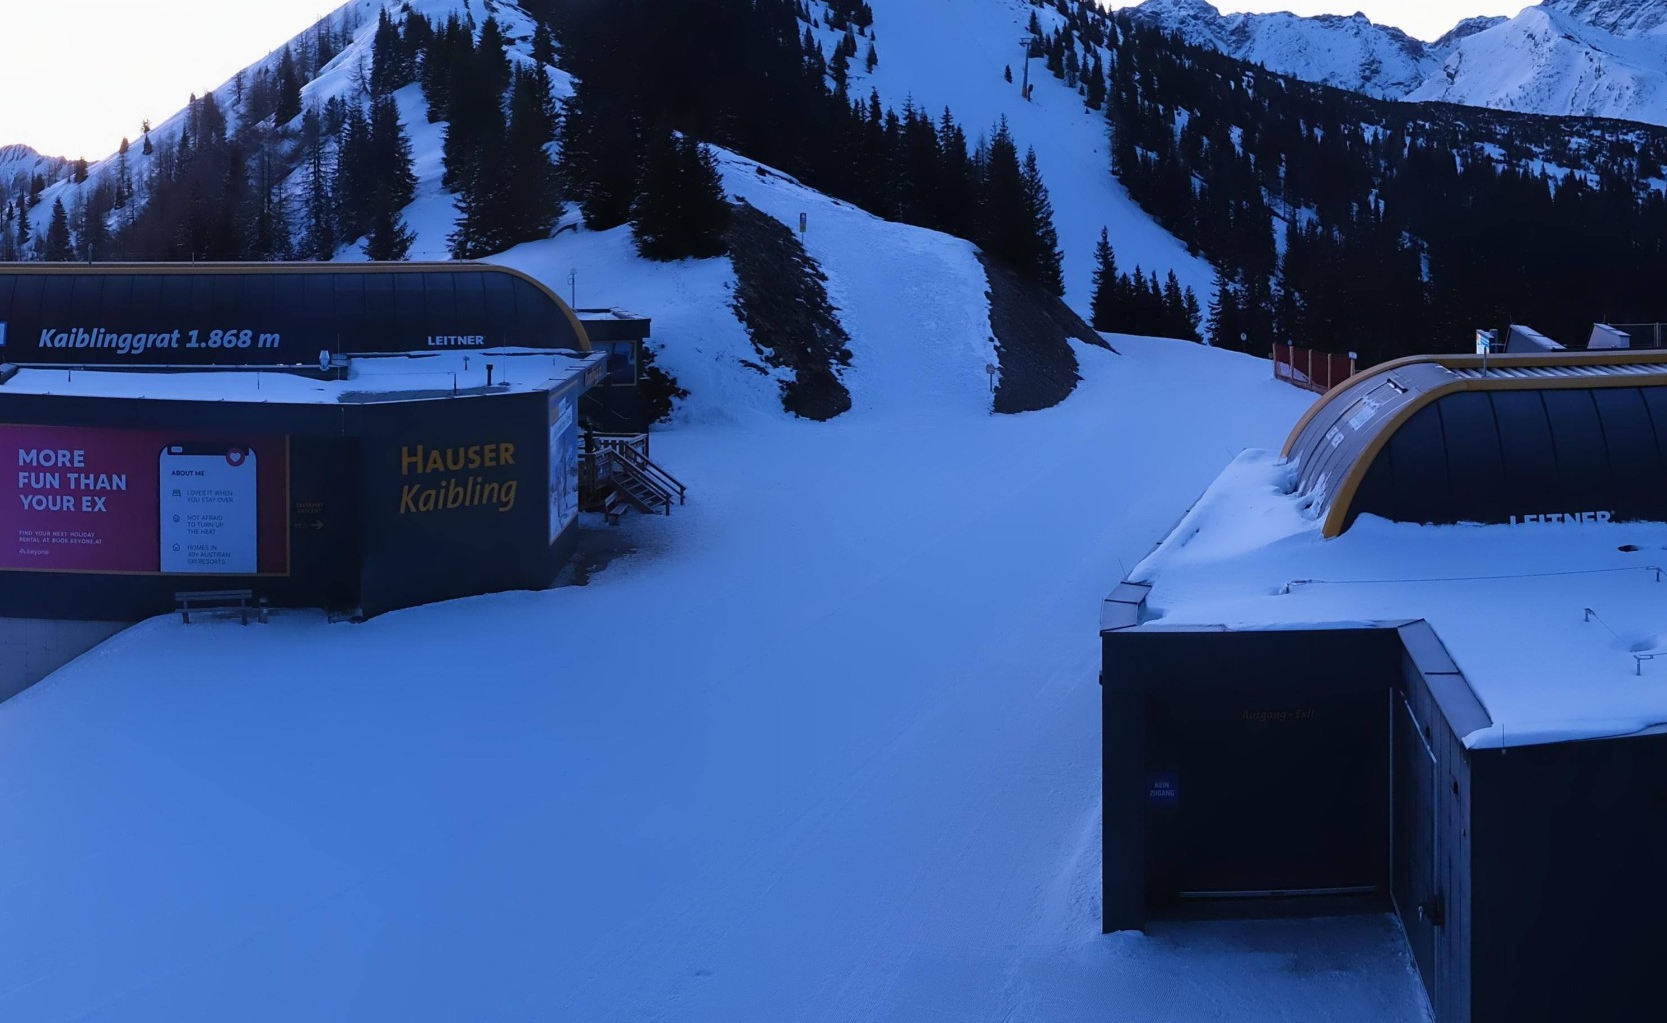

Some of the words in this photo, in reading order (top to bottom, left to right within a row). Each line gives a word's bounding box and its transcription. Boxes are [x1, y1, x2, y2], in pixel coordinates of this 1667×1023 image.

[38, 327, 181, 354] Kaiblinggrat
[185, 328, 252, 349] 1.868
[257, 333, 280, 348] m
[427, 335, 484, 345] LEITNER
[18, 448, 85, 468] MORE
[401, 442, 516, 475] HAUSER
[18, 471, 60, 489] FUN
[66, 473, 127, 491] THAN
[19, 494, 76, 511] YOUR
[81, 496, 107, 512] EX
[399, 476, 518, 514] Kaibling
